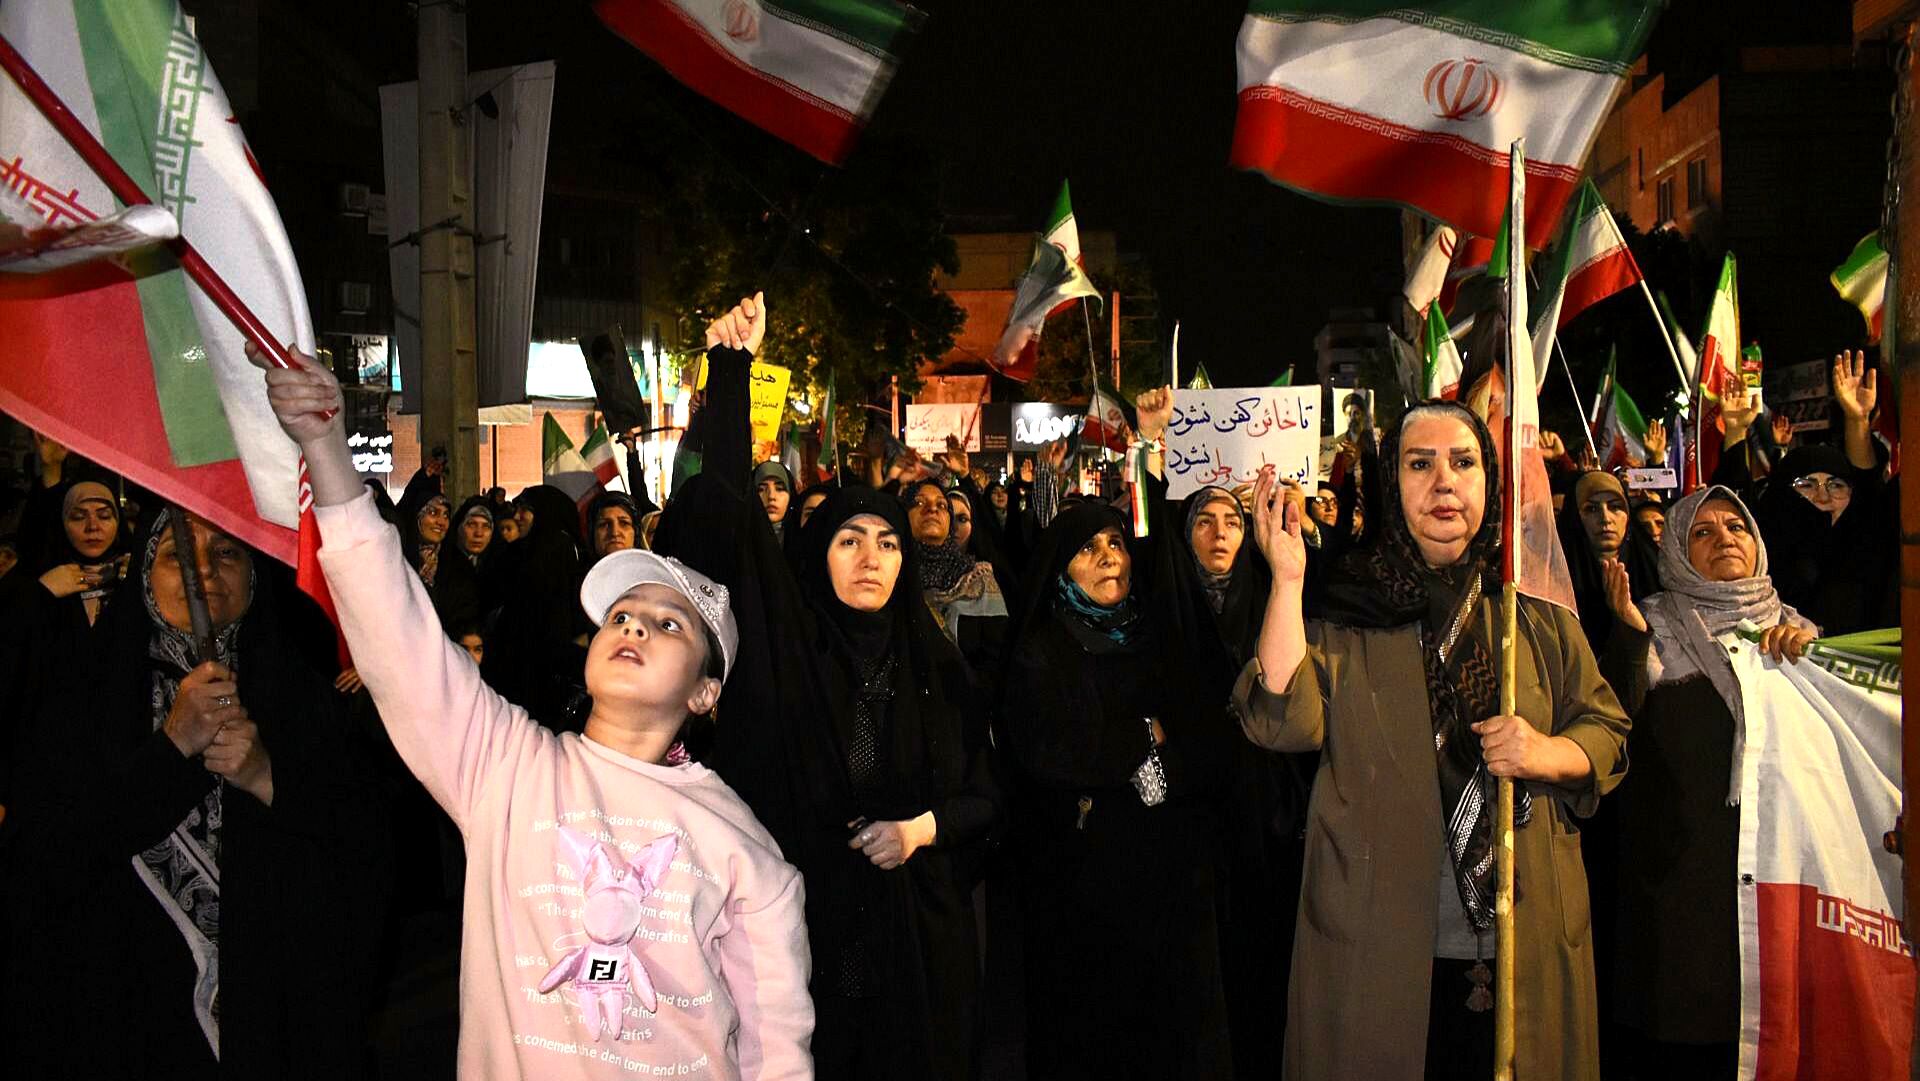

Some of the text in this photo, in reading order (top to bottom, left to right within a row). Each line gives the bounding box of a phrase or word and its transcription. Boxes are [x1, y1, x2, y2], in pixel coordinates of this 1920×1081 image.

[1167, 402, 1211, 436] نشود
[1214, 397, 1261, 432] کفن
[1298, 396, 1313, 429] تا
[1168, 443, 1211, 475] نشود
[659, 908, 681, 921] end
[677, 996, 689, 1007] to
[692, 988, 712, 1006] end
[600, 1049, 622, 1065] den
[652, 1063, 675, 1076] end
[677, 1063, 689, 1076] to
